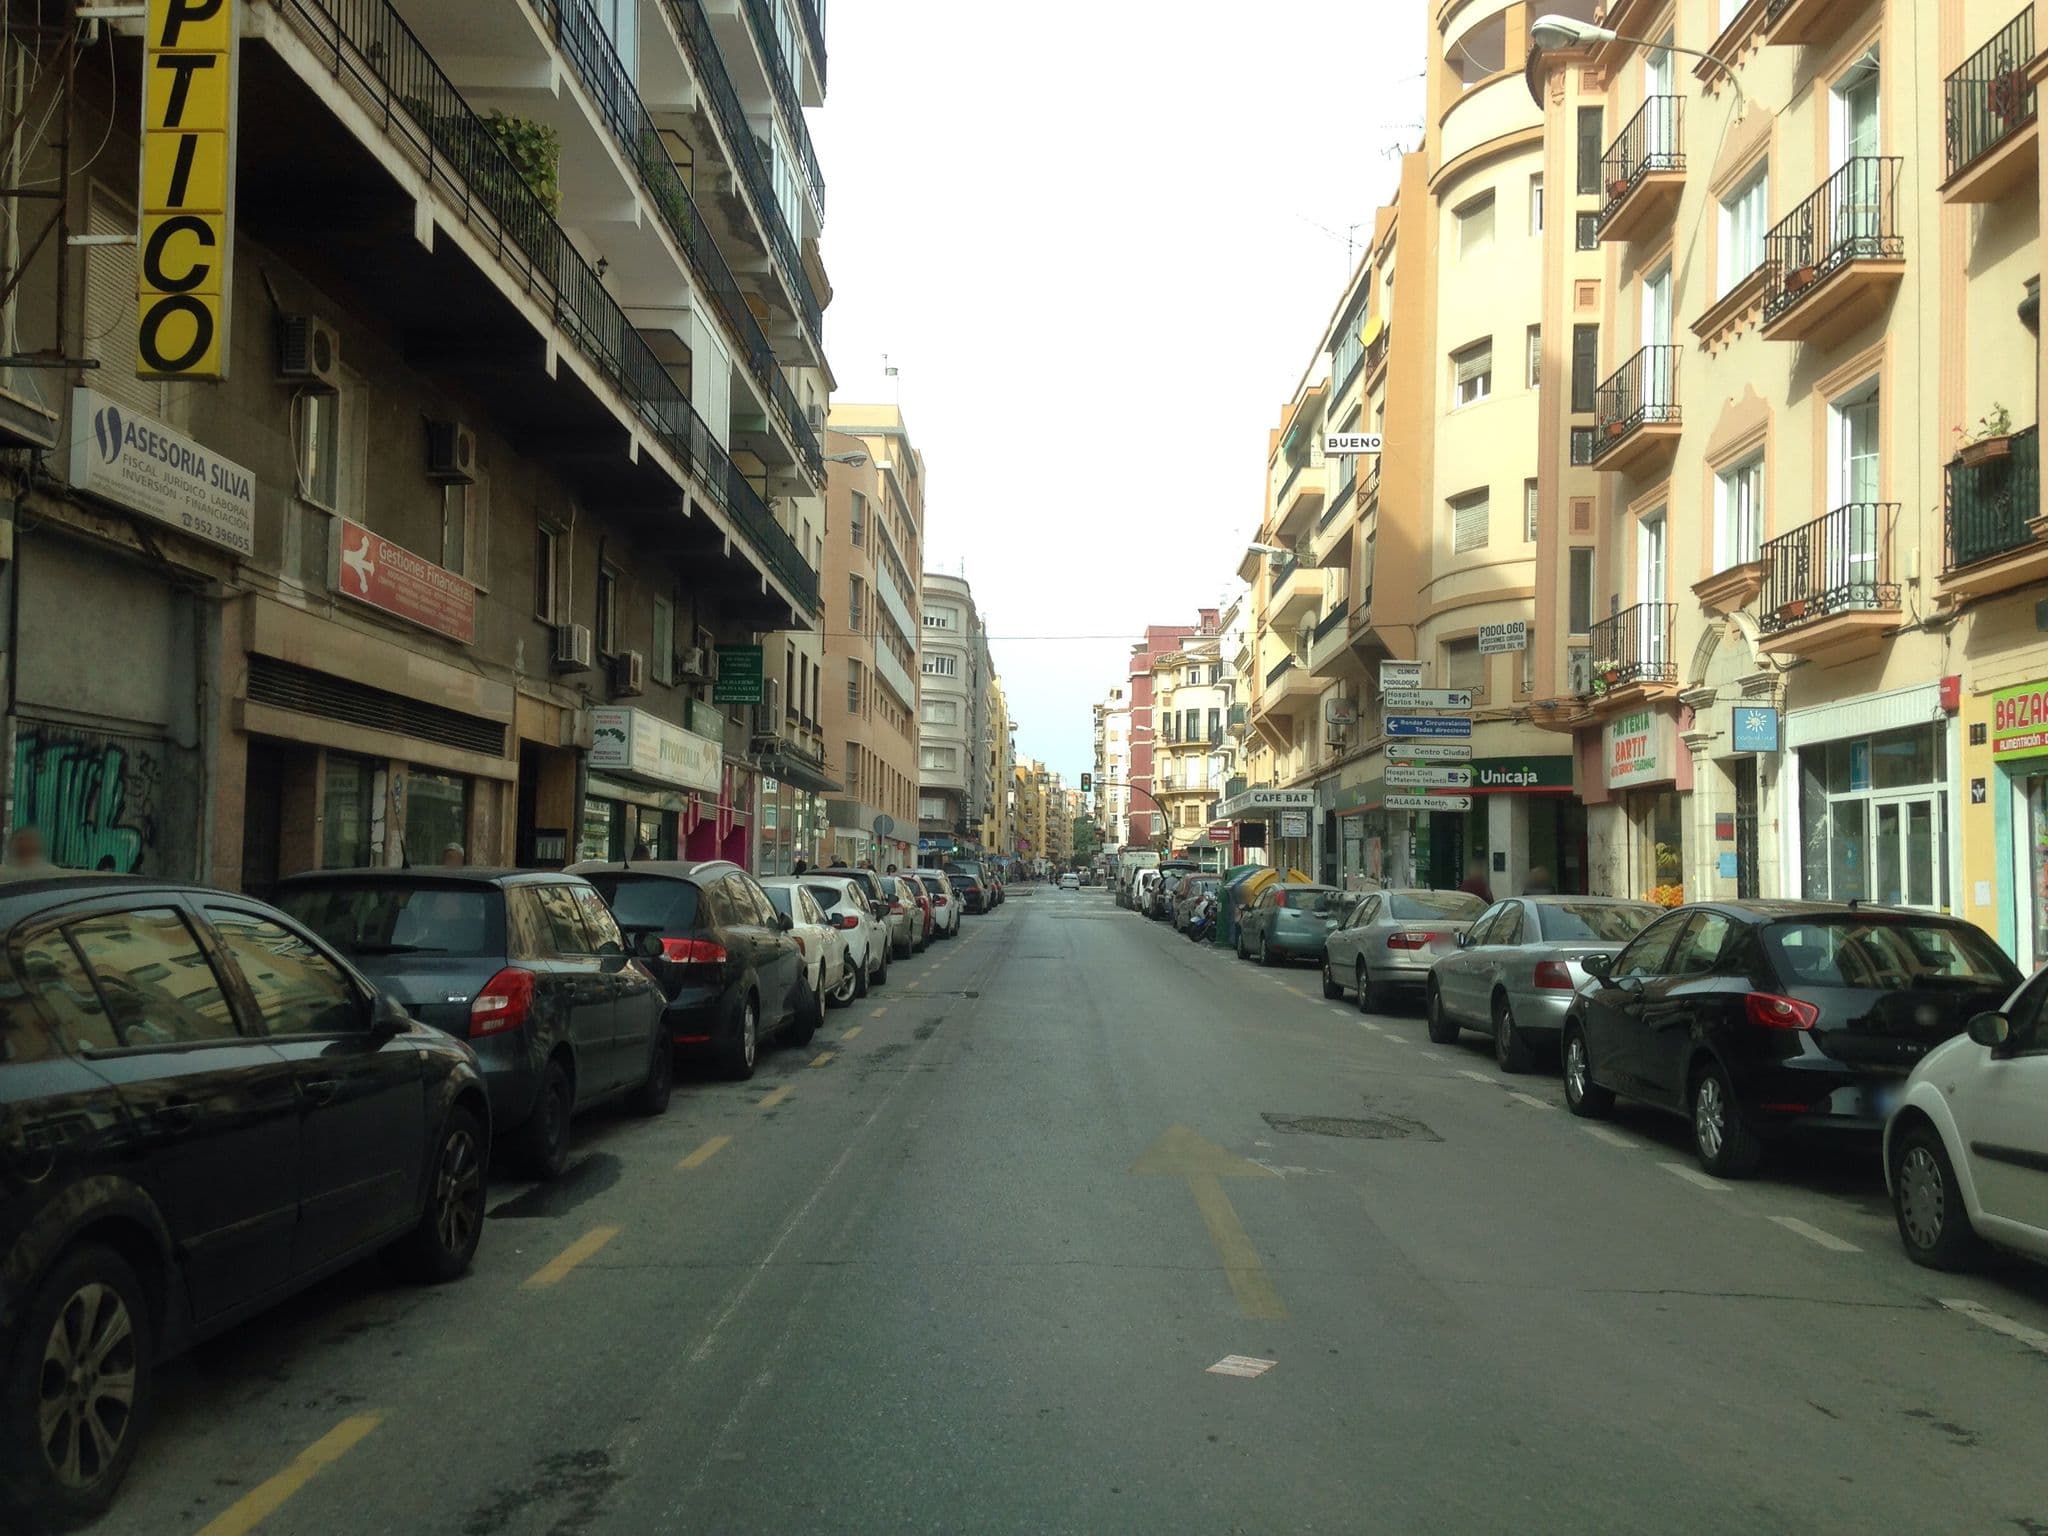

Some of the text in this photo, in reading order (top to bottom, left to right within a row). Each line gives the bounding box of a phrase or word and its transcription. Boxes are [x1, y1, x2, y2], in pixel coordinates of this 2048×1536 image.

[1328, 437, 1381, 448] BUENO
[124, 421, 207, 482] ASESORIA
[211, 464, 250, 502] SILVA
[122, 453, 157, 478] FISCAL
[210, 494, 249, 520] LABORAL
[194, 518, 250, 551] 952 396055
[379, 541, 425, 579] Gestiones
[1480, 622, 1524, 637] PODOLOGO
[1435, 726, 1470, 734] direcciones
[1414, 747, 1470, 757] Centro Ciudad
[1480, 766, 1538, 787] Unicaja
[1286, 794, 1308, 802] BAR
